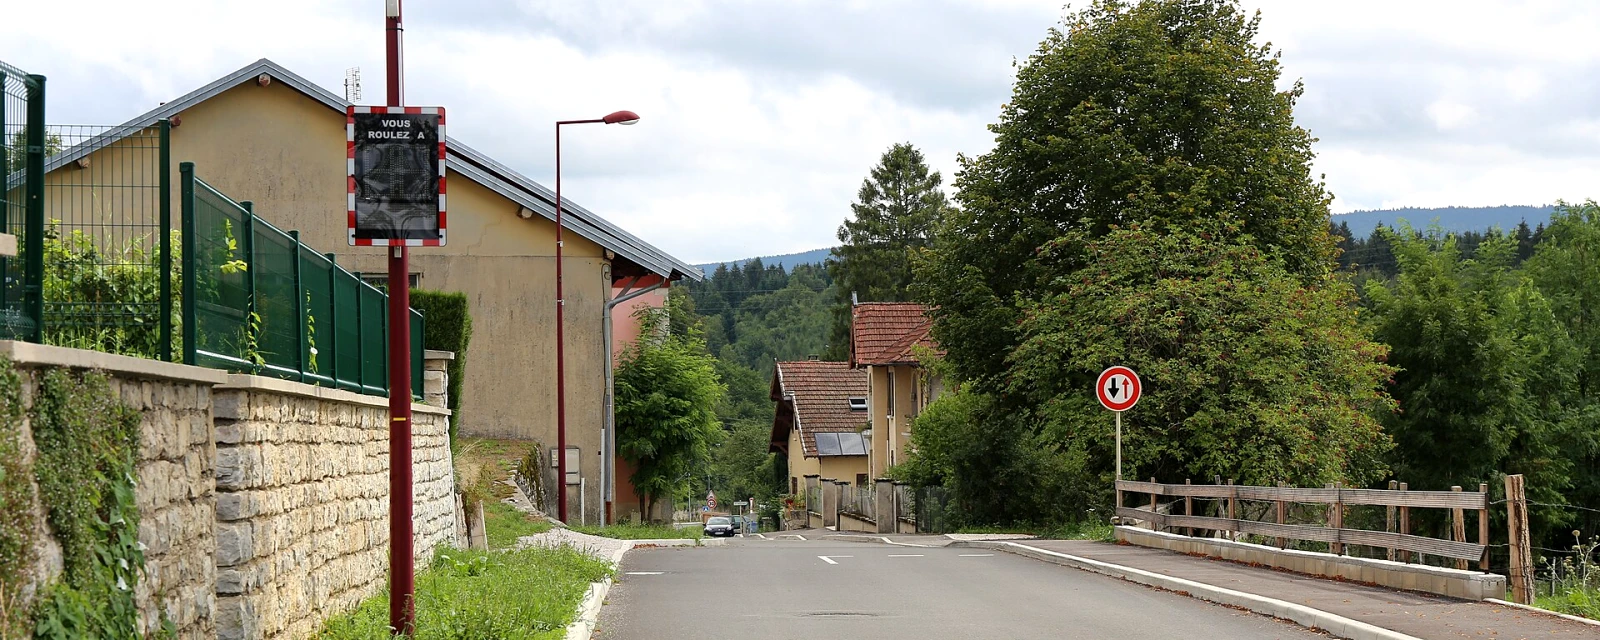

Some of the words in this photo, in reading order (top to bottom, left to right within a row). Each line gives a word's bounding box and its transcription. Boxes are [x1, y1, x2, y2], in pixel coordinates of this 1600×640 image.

[381, 119, 411, 127] VOUS
[368, 131, 410, 139] ROULEZ
[417, 131, 425, 139] A
